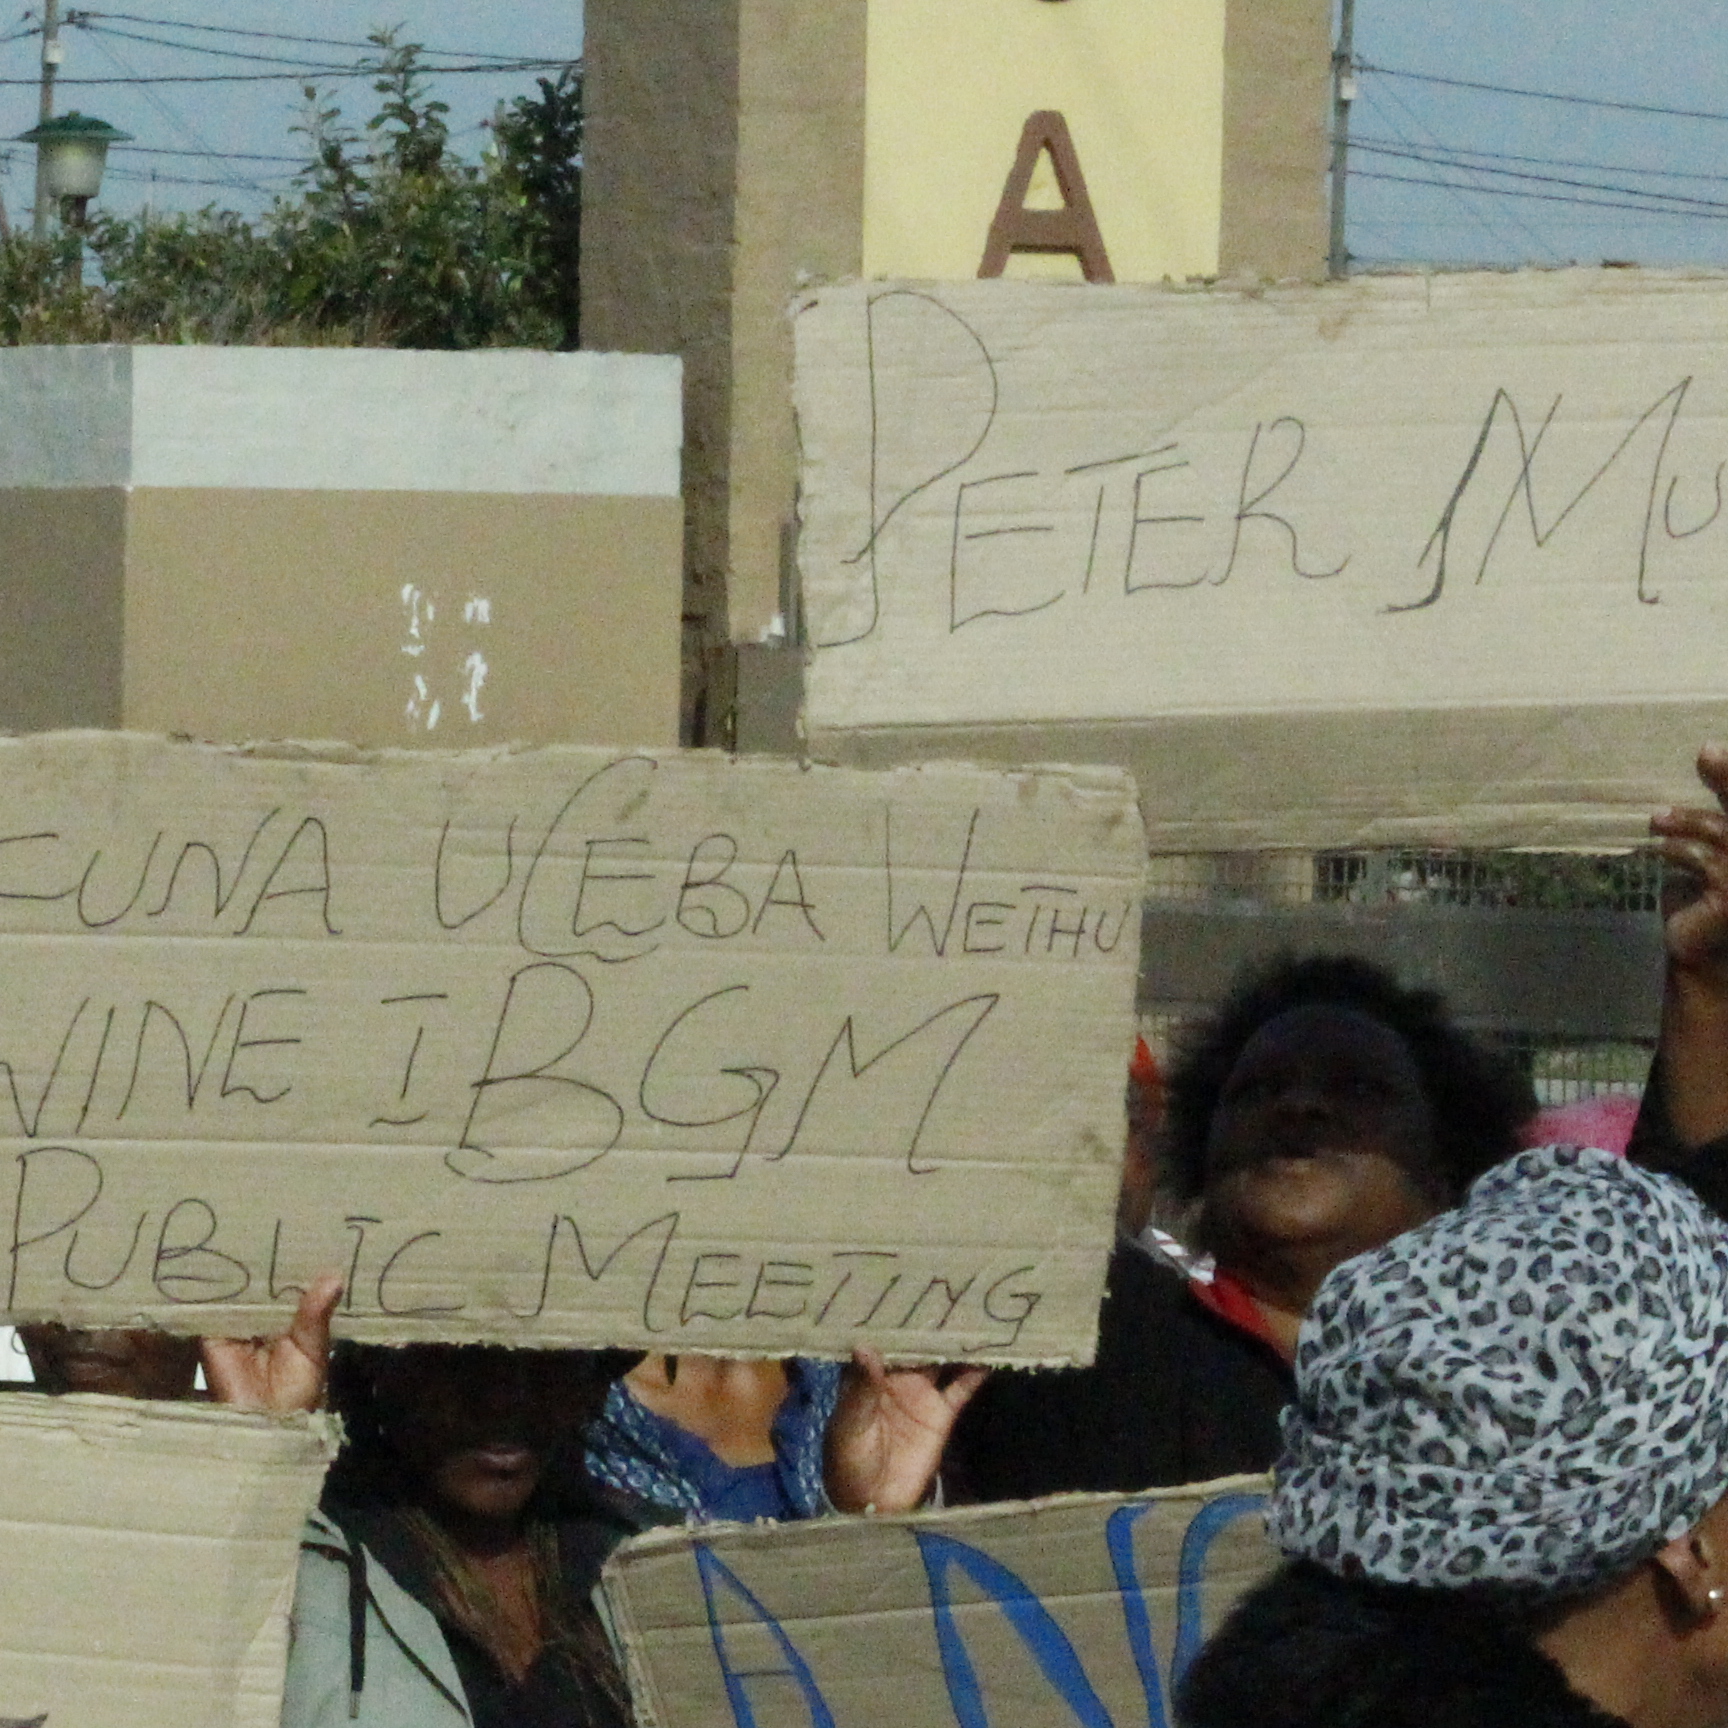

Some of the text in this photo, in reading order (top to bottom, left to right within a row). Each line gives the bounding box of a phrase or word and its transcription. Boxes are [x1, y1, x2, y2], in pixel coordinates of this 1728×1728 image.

[816, 290, 1350, 648] PETER
[884, 804, 1131, 957] WETHU
[6, 1146, 465, 1317] PUBLIC
[514, 1210, 1043, 1352] MEETING
